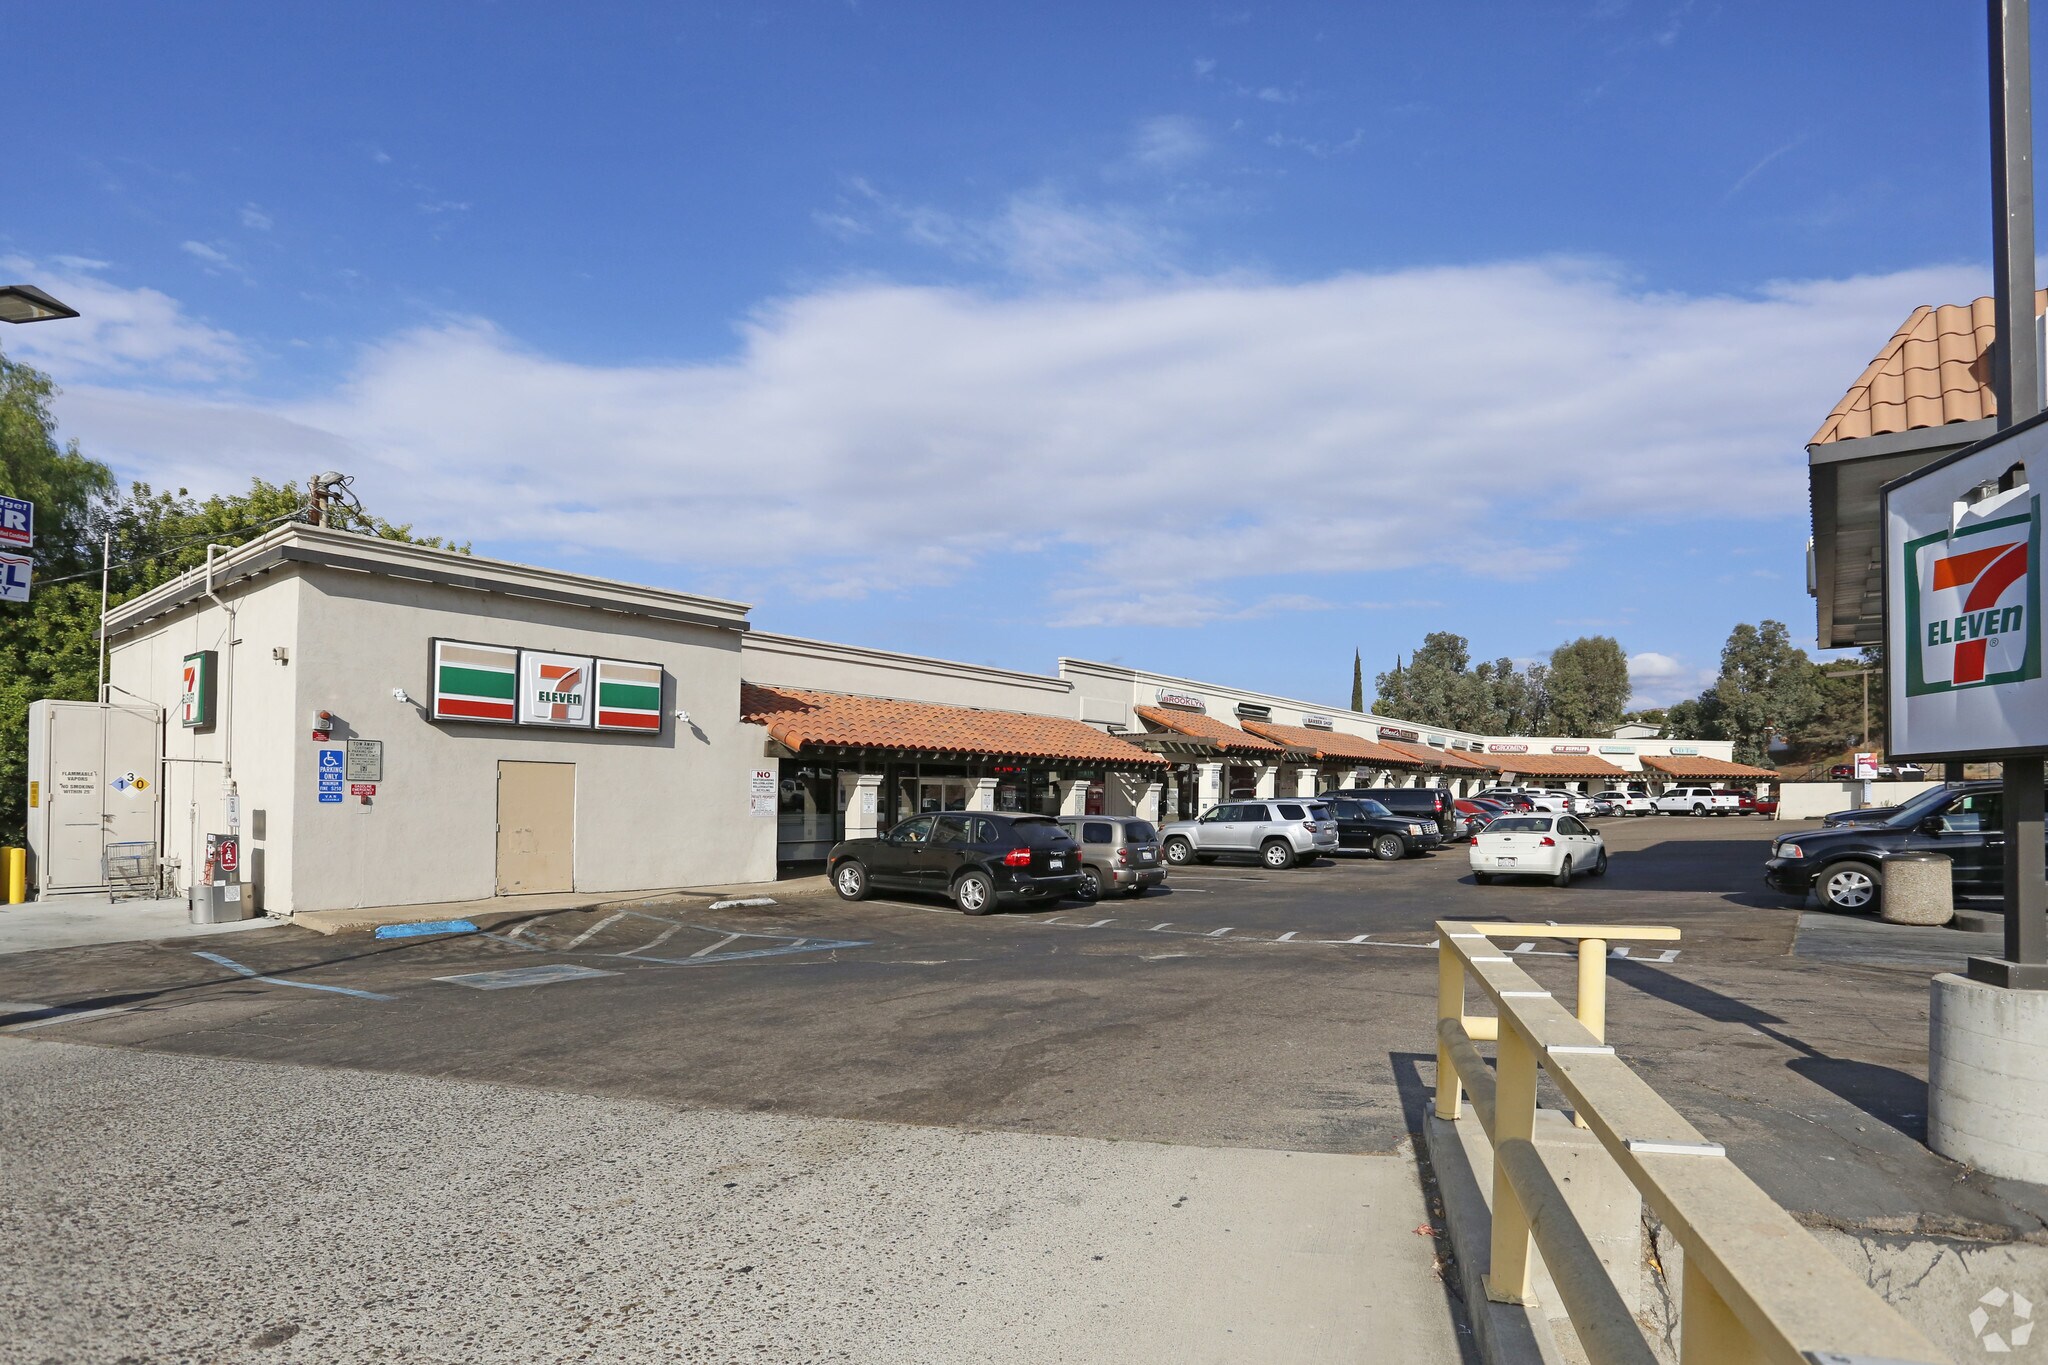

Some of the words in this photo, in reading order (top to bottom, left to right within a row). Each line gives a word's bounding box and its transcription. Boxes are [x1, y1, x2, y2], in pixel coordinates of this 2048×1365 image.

[1933, 541, 2028, 684] 7
[183, 666, 195, 720] 7
[540, 664, 582, 720] 7
[1163, 696, 1204, 707] BROOKLYN
[126, 772, 135, 782] 3
[118, 780, 124, 789] 1
[136, 780, 144, 789] 0
